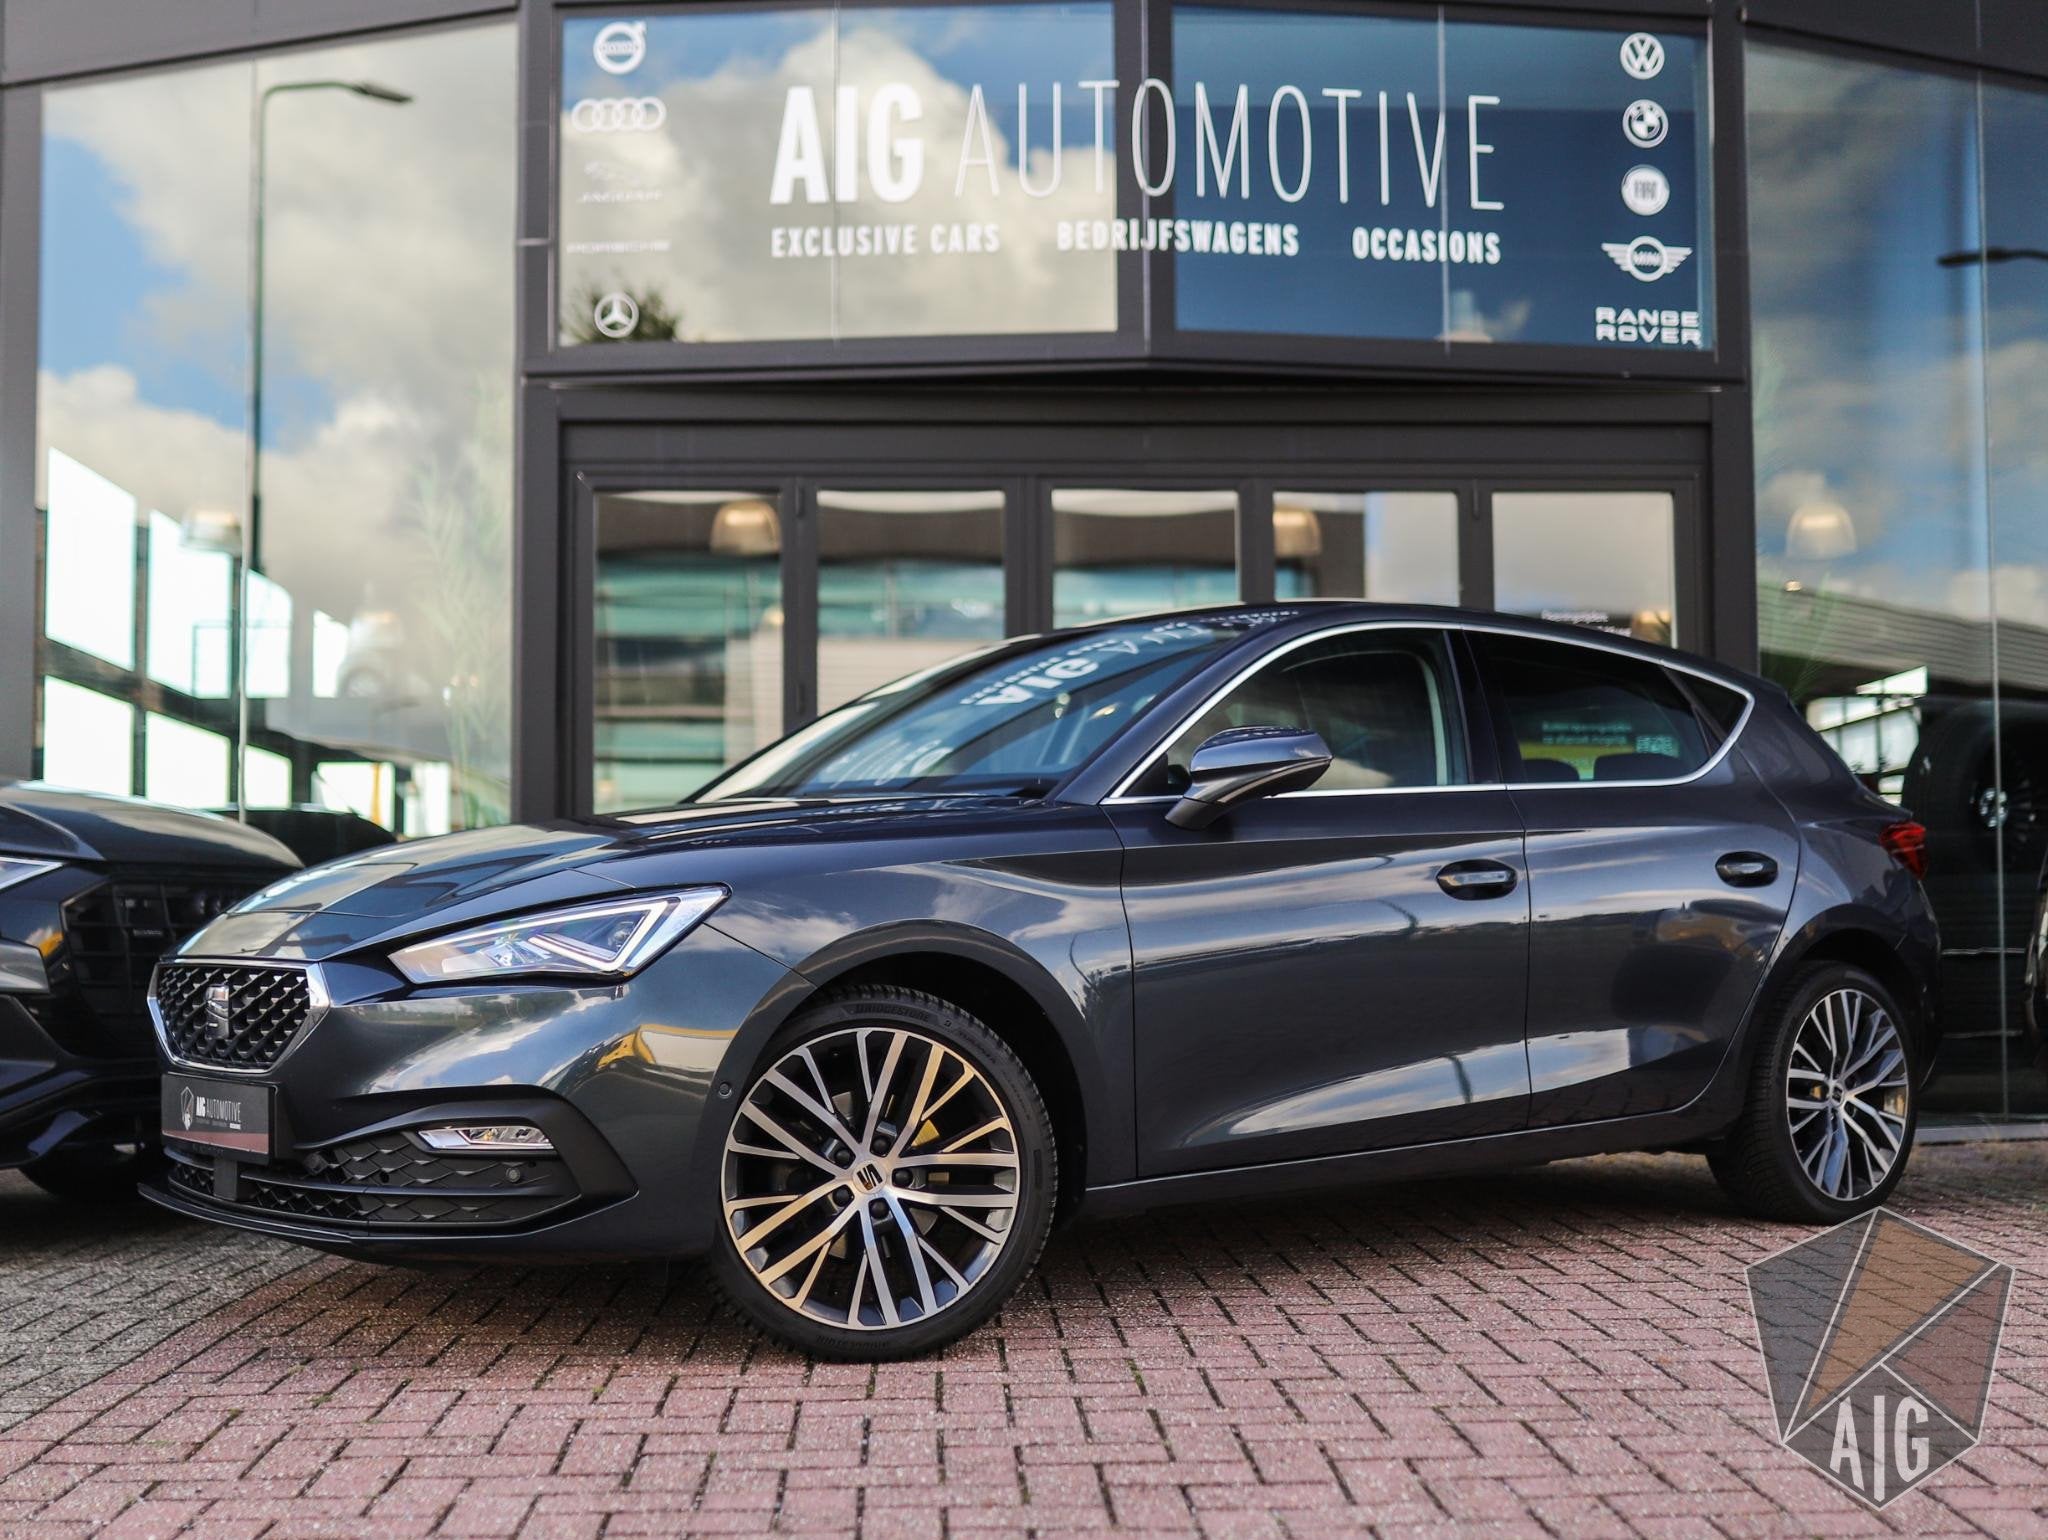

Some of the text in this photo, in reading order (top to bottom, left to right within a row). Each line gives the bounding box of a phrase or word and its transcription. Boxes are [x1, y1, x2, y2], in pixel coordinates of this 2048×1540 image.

[769, 78, 1504, 211] AIG AUTOMOTIVE
[770, 222, 1000, 258] EXCLUSIVE CARS
[1056, 217, 1299, 257] BEDRIJFSWAGENS
[1352, 226, 1501, 265] OCCASIONS
[1595, 306, 1700, 328] RANGE
[1596, 323, 1702, 348] ROVER
[206, 1098, 241, 1123] AUTOMOTIVE
